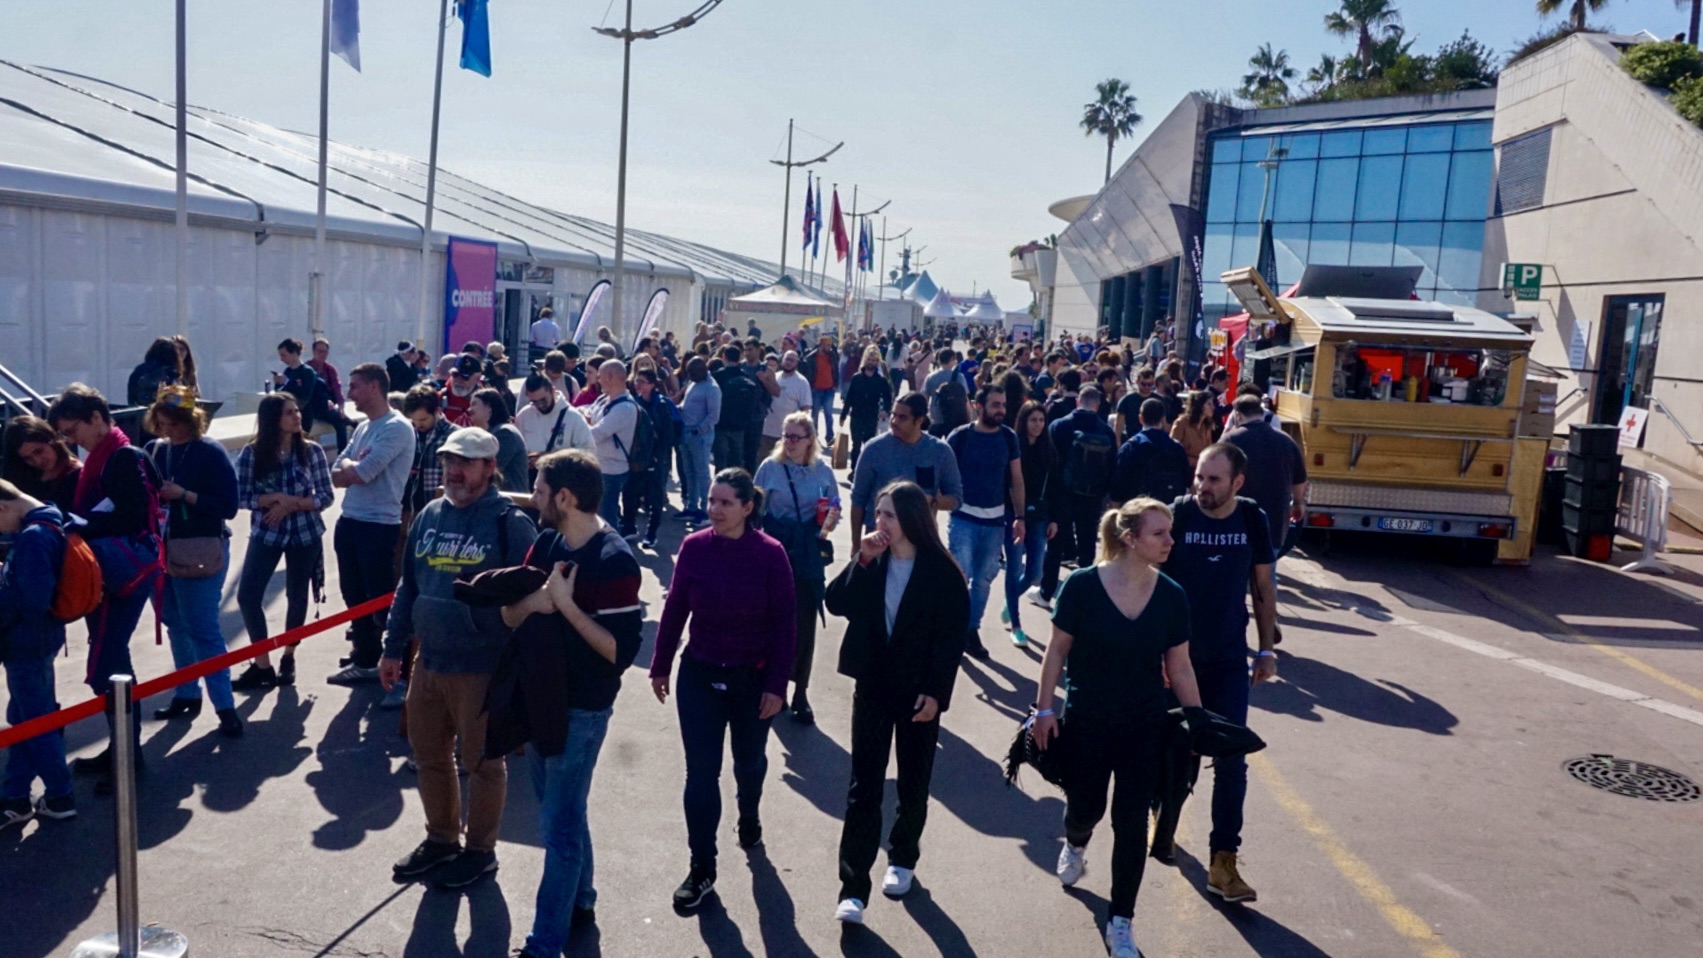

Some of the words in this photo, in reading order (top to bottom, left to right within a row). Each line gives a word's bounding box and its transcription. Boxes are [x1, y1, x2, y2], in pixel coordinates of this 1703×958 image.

[1521, 265, 1538, 285] P
[451, 286, 493, 308] CONTRÉE
[1185, 532, 1248, 545] HOLLISTER
